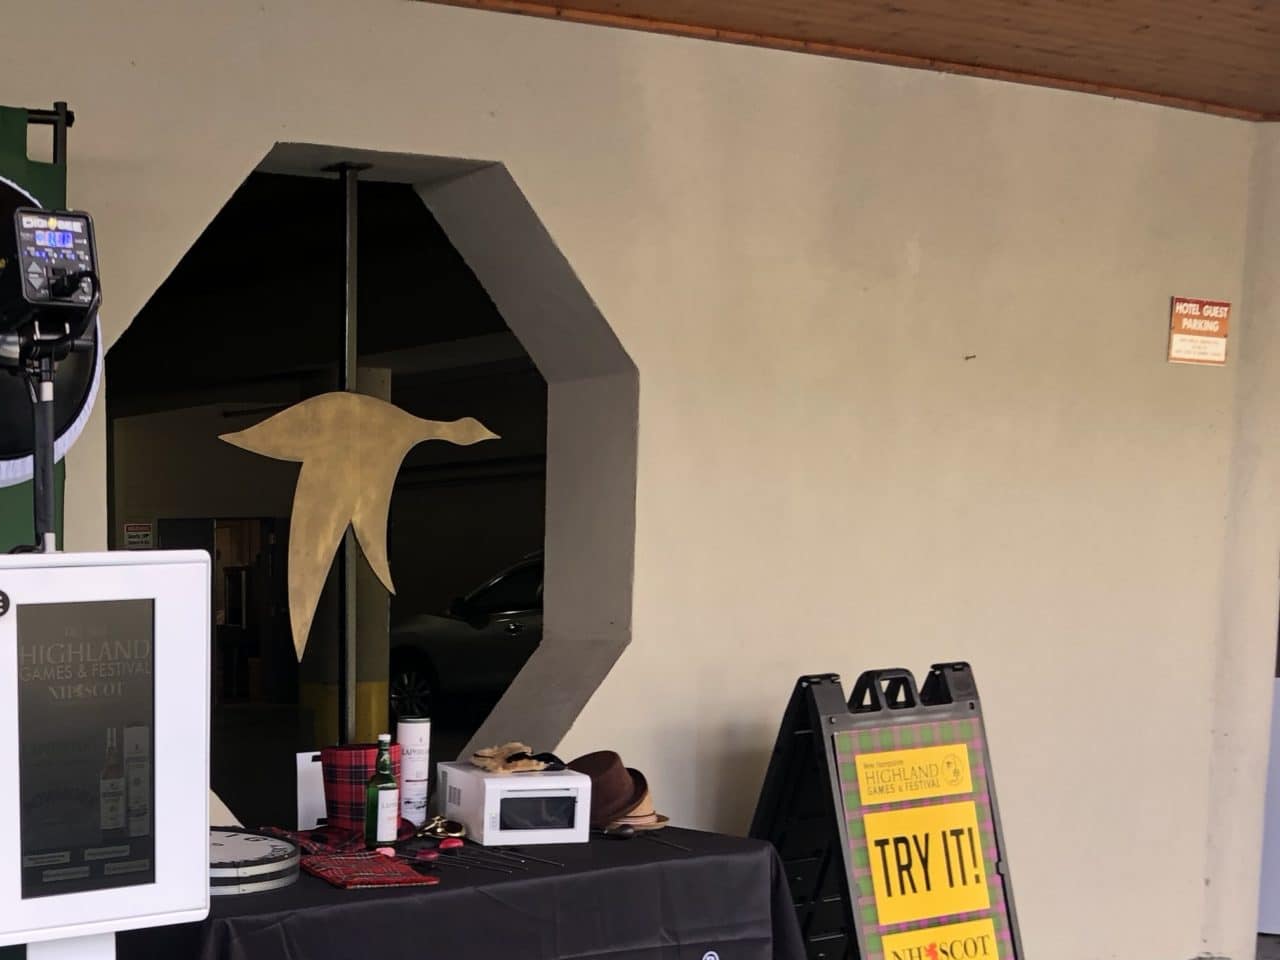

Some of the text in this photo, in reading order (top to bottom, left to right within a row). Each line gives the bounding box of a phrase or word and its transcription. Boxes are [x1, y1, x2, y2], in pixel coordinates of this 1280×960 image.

[1175, 302, 1229, 318] HOTEL GUEST
[1182, 318, 1220, 332] PARKING
[21, 640, 151, 665] HIGHLAND
[865, 763, 940, 785] HIGHLAND
[868, 783, 896, 796] GAMES
[905, 778, 941, 792] FESTIVAL
[874, 826, 982, 898] TRY IT!
